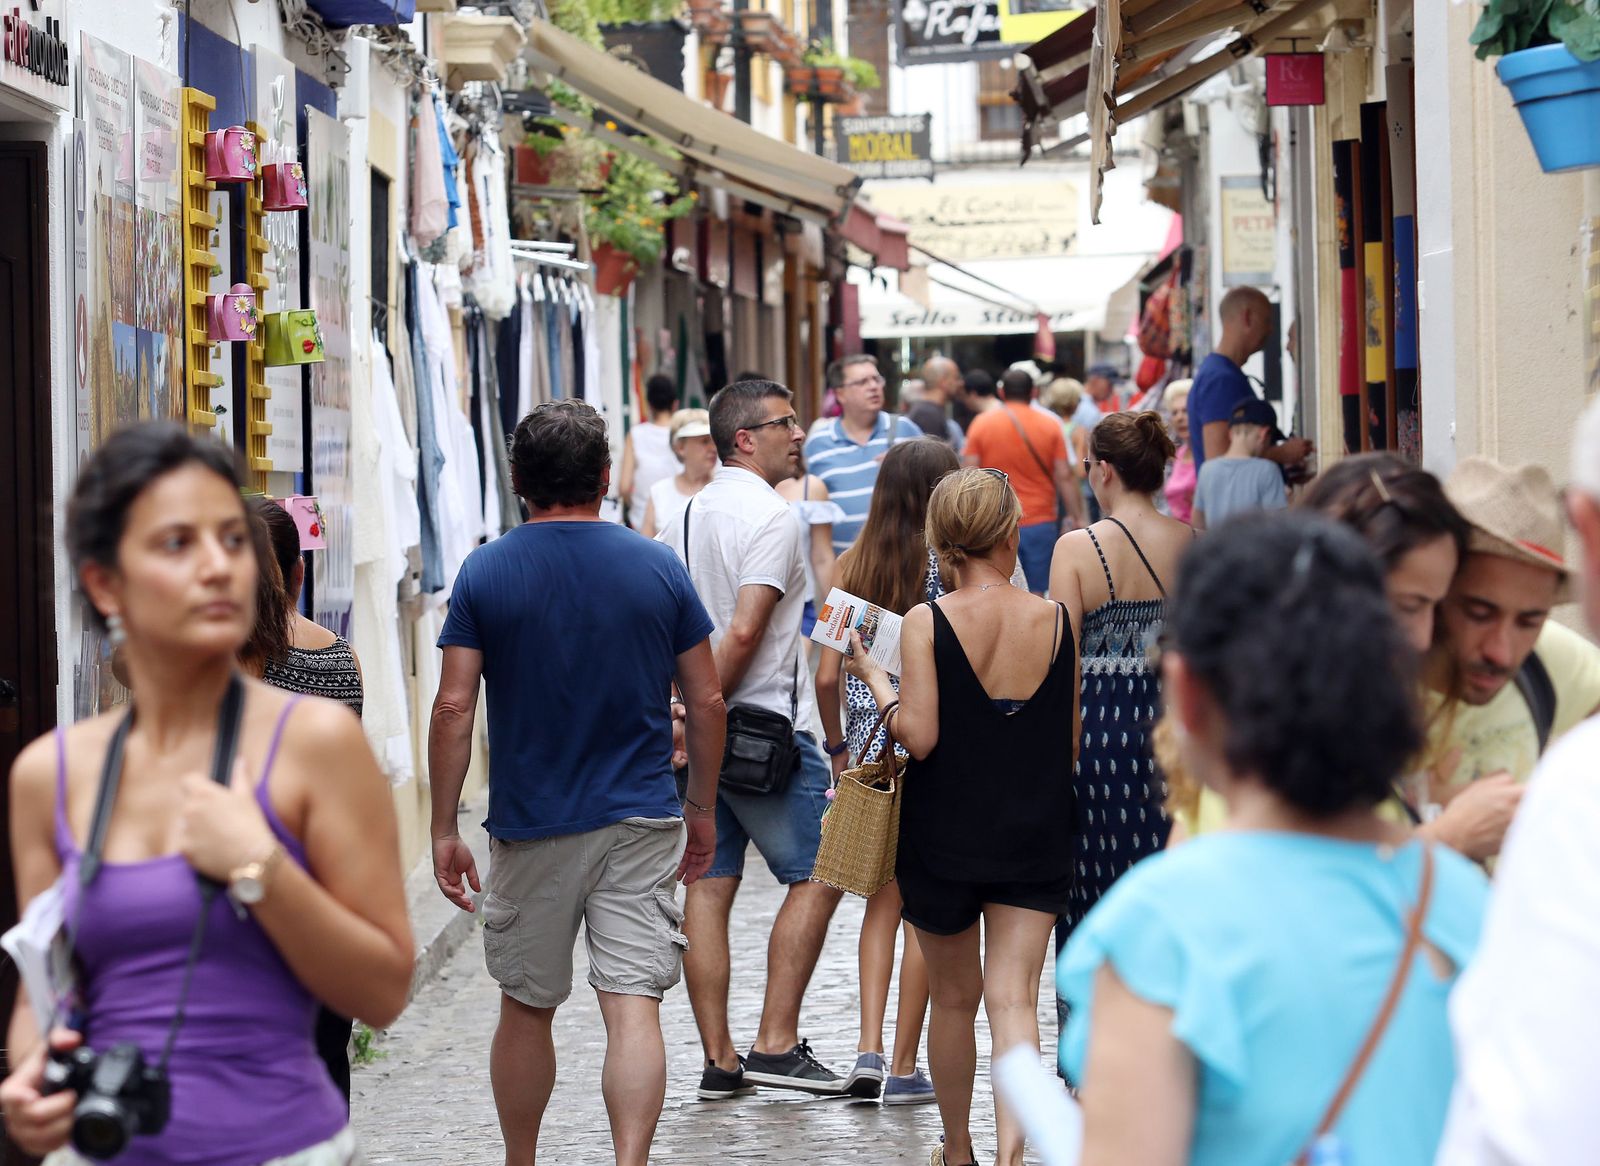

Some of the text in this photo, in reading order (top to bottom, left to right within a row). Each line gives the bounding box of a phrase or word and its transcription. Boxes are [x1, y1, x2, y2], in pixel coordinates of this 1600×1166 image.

[848, 132, 921, 162] MORAL
[889, 309, 957, 328] Sello
[825, 600, 847, 639] Andalousie
